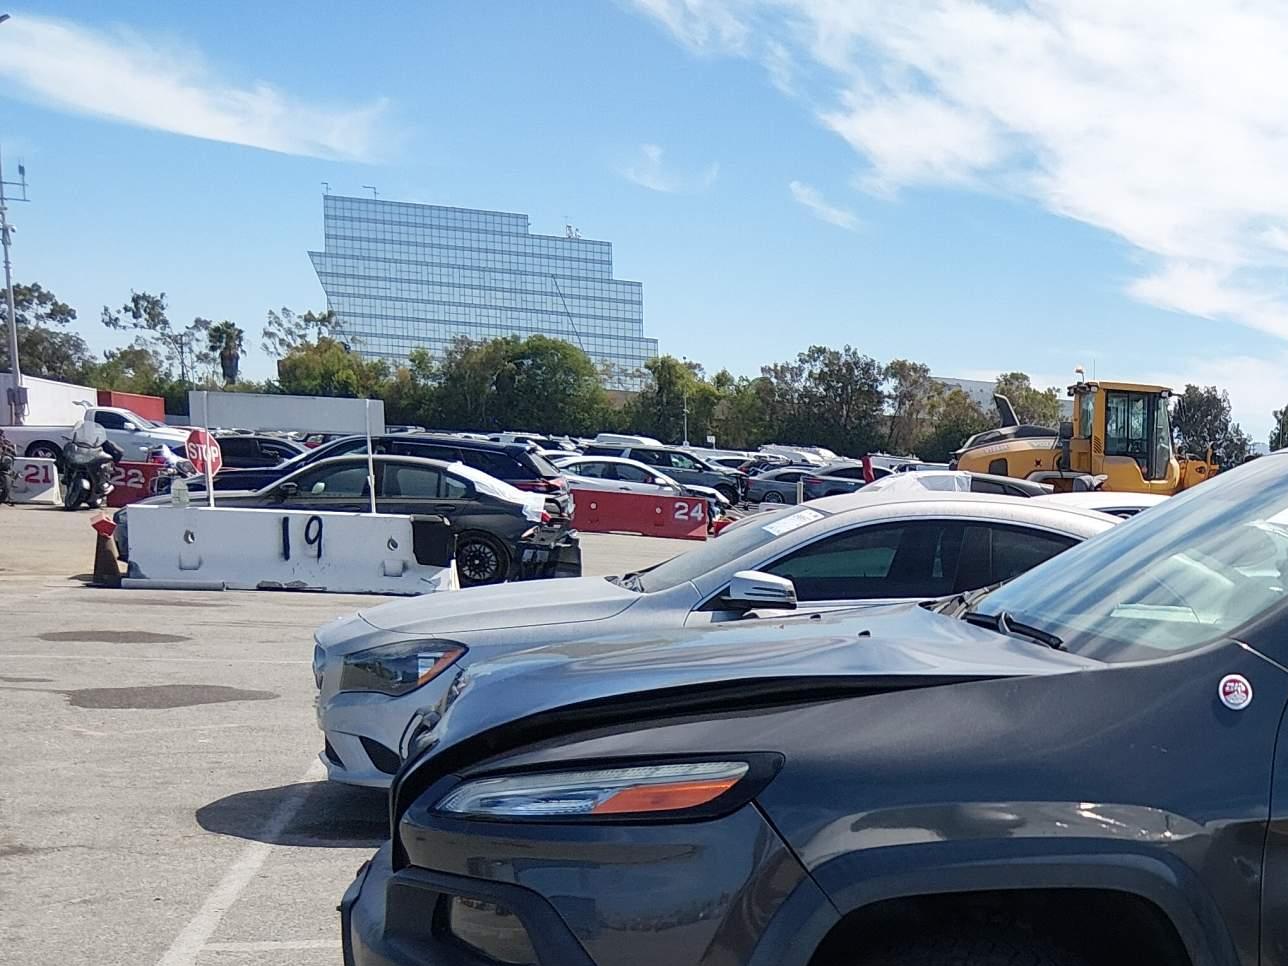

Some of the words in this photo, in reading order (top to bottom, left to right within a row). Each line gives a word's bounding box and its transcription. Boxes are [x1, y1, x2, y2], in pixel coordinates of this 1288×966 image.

[188, 442, 219, 463] STOP
[24, 463, 52, 484] 21
[111, 466, 148, 489] 22
[674, 502, 704, 521] 24
[282, 515, 323, 562] 19
